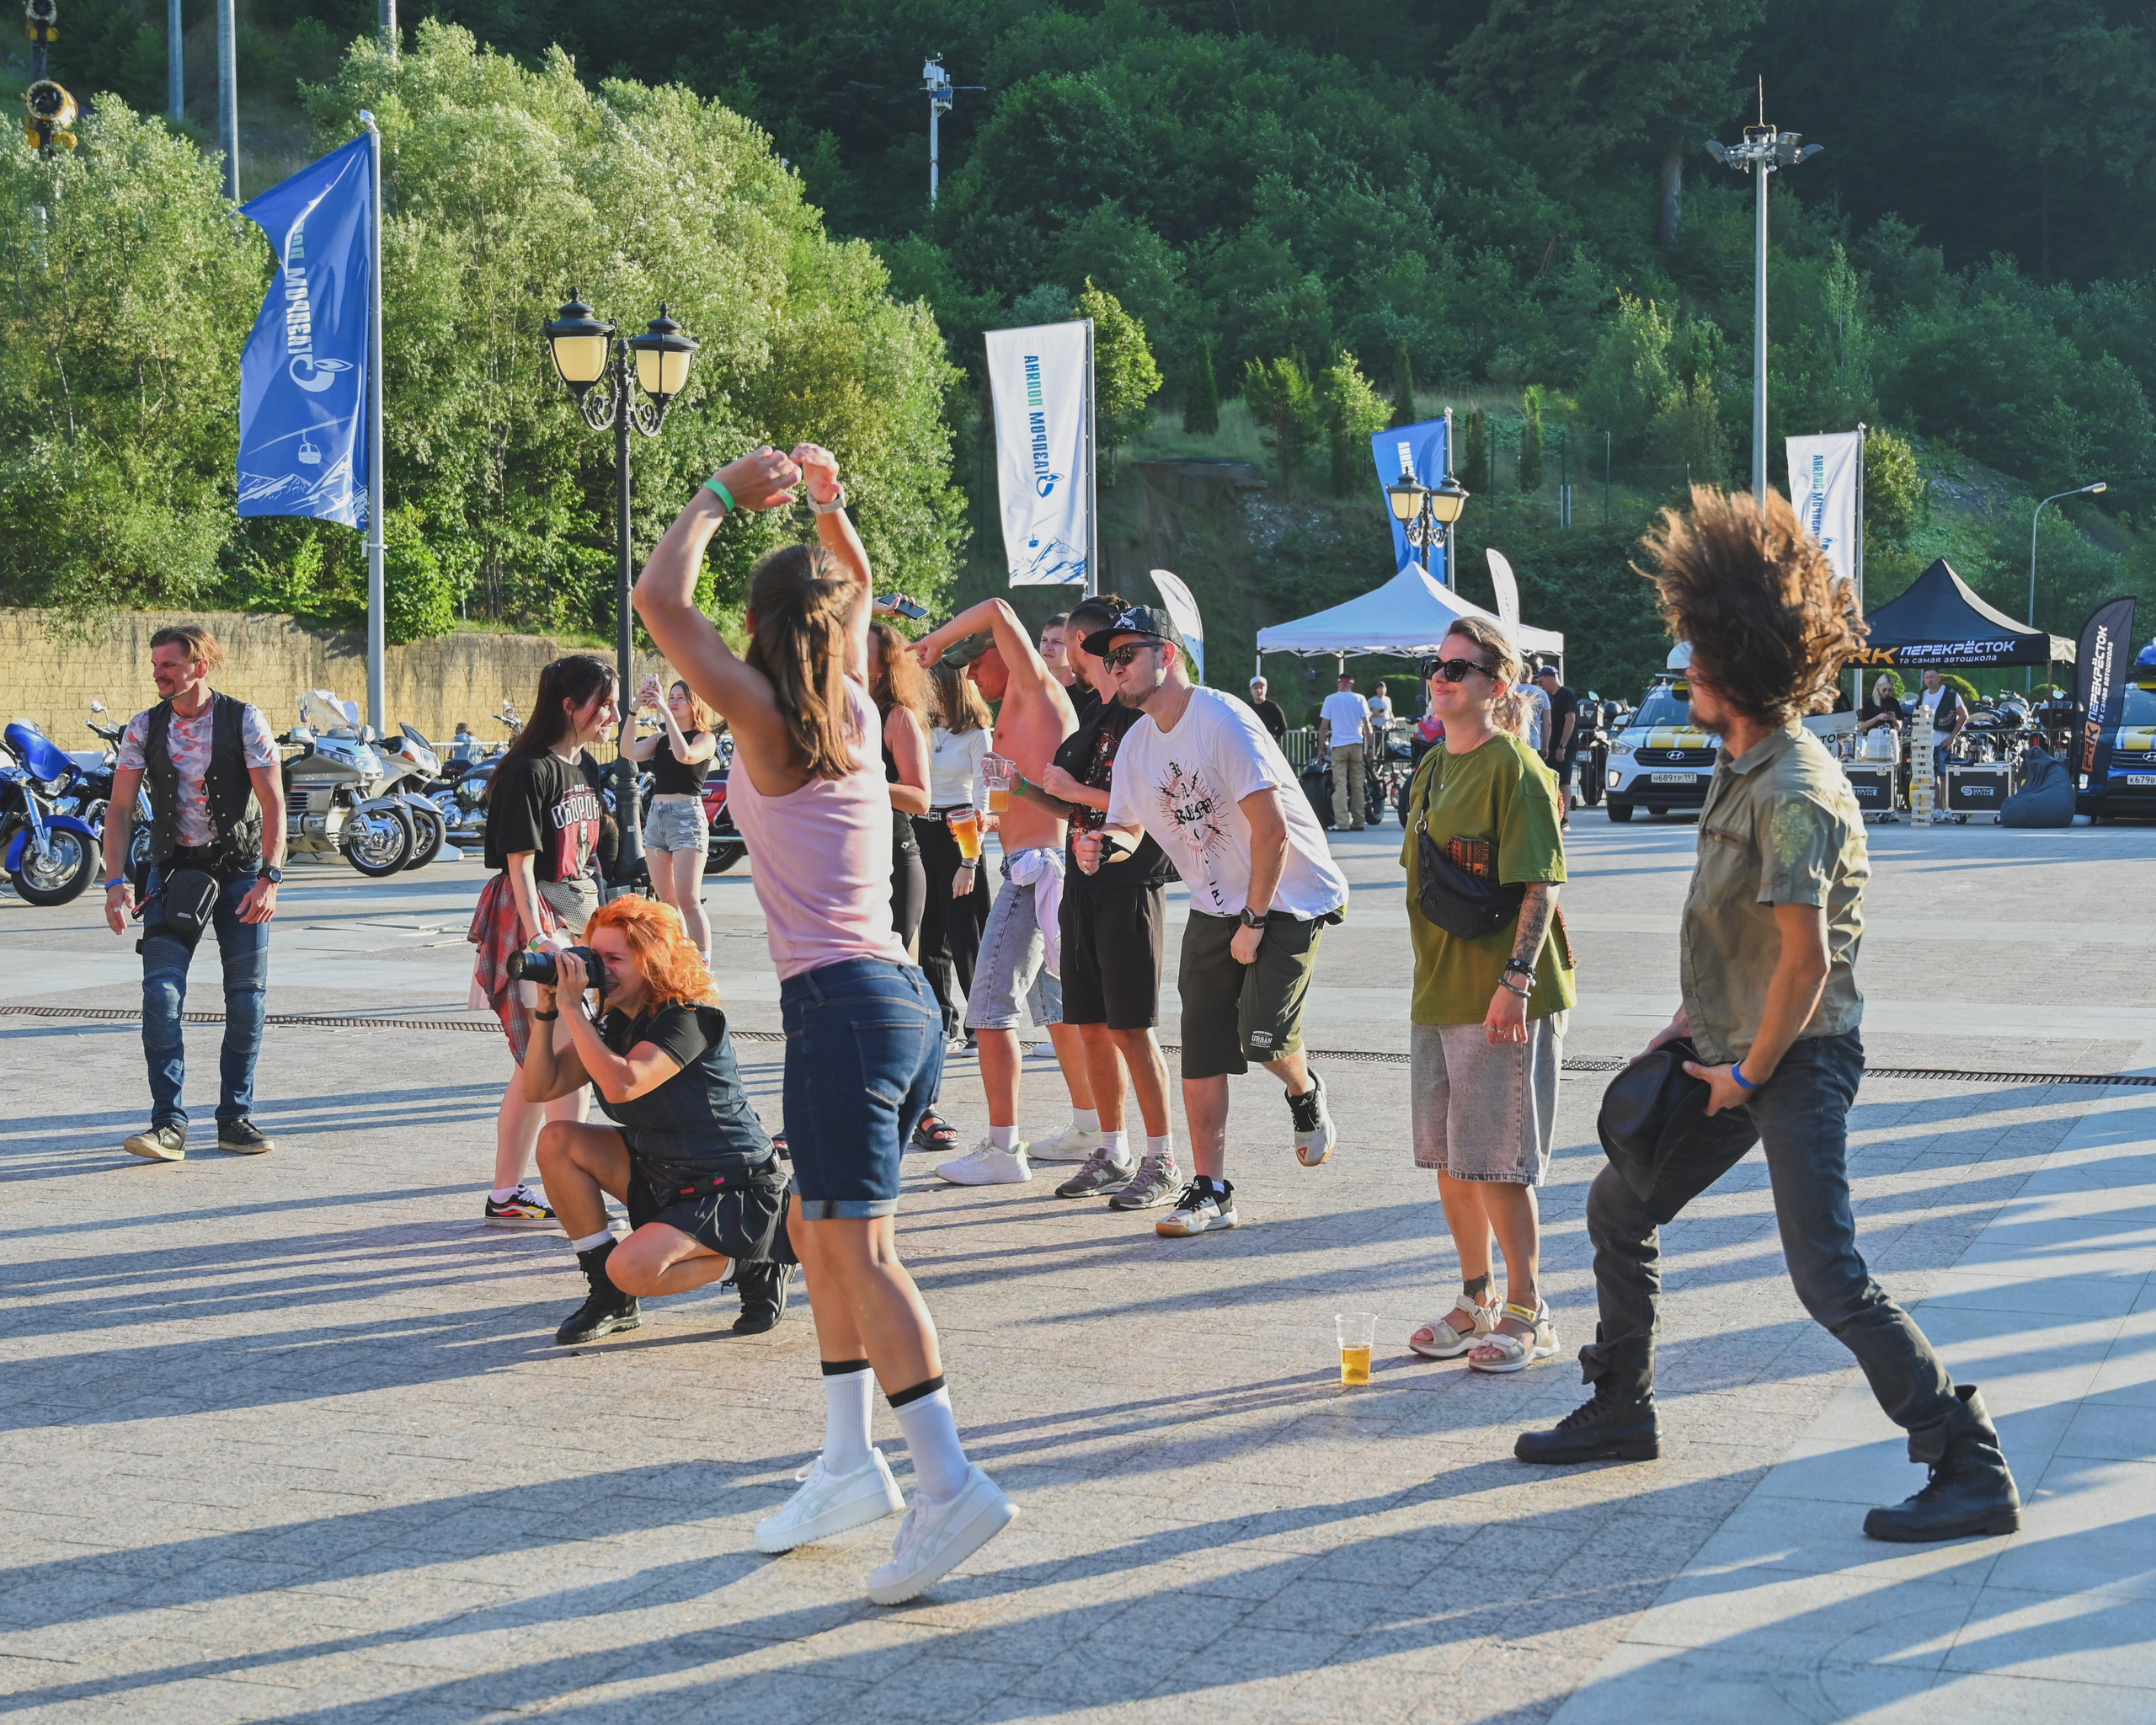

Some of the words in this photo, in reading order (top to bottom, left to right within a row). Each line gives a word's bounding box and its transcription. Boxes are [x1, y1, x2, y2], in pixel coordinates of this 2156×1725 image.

[1848, 647, 1899, 664] RK
[1900, 640, 2015, 656] ПЕРЕКРЁСТОК
[2088, 624, 2108, 722] ПЕРЕКРЁСТОК
[2103, 642, 2114, 686] автошкола
[2100, 686, 2109, 712] самая
[2098, 713, 2104, 723] та
[2084, 724, 2099, 769] PRK
[551, 794, 600, 830] ОБОРОН
[1251, 1034, 1273, 1044] URBAN
